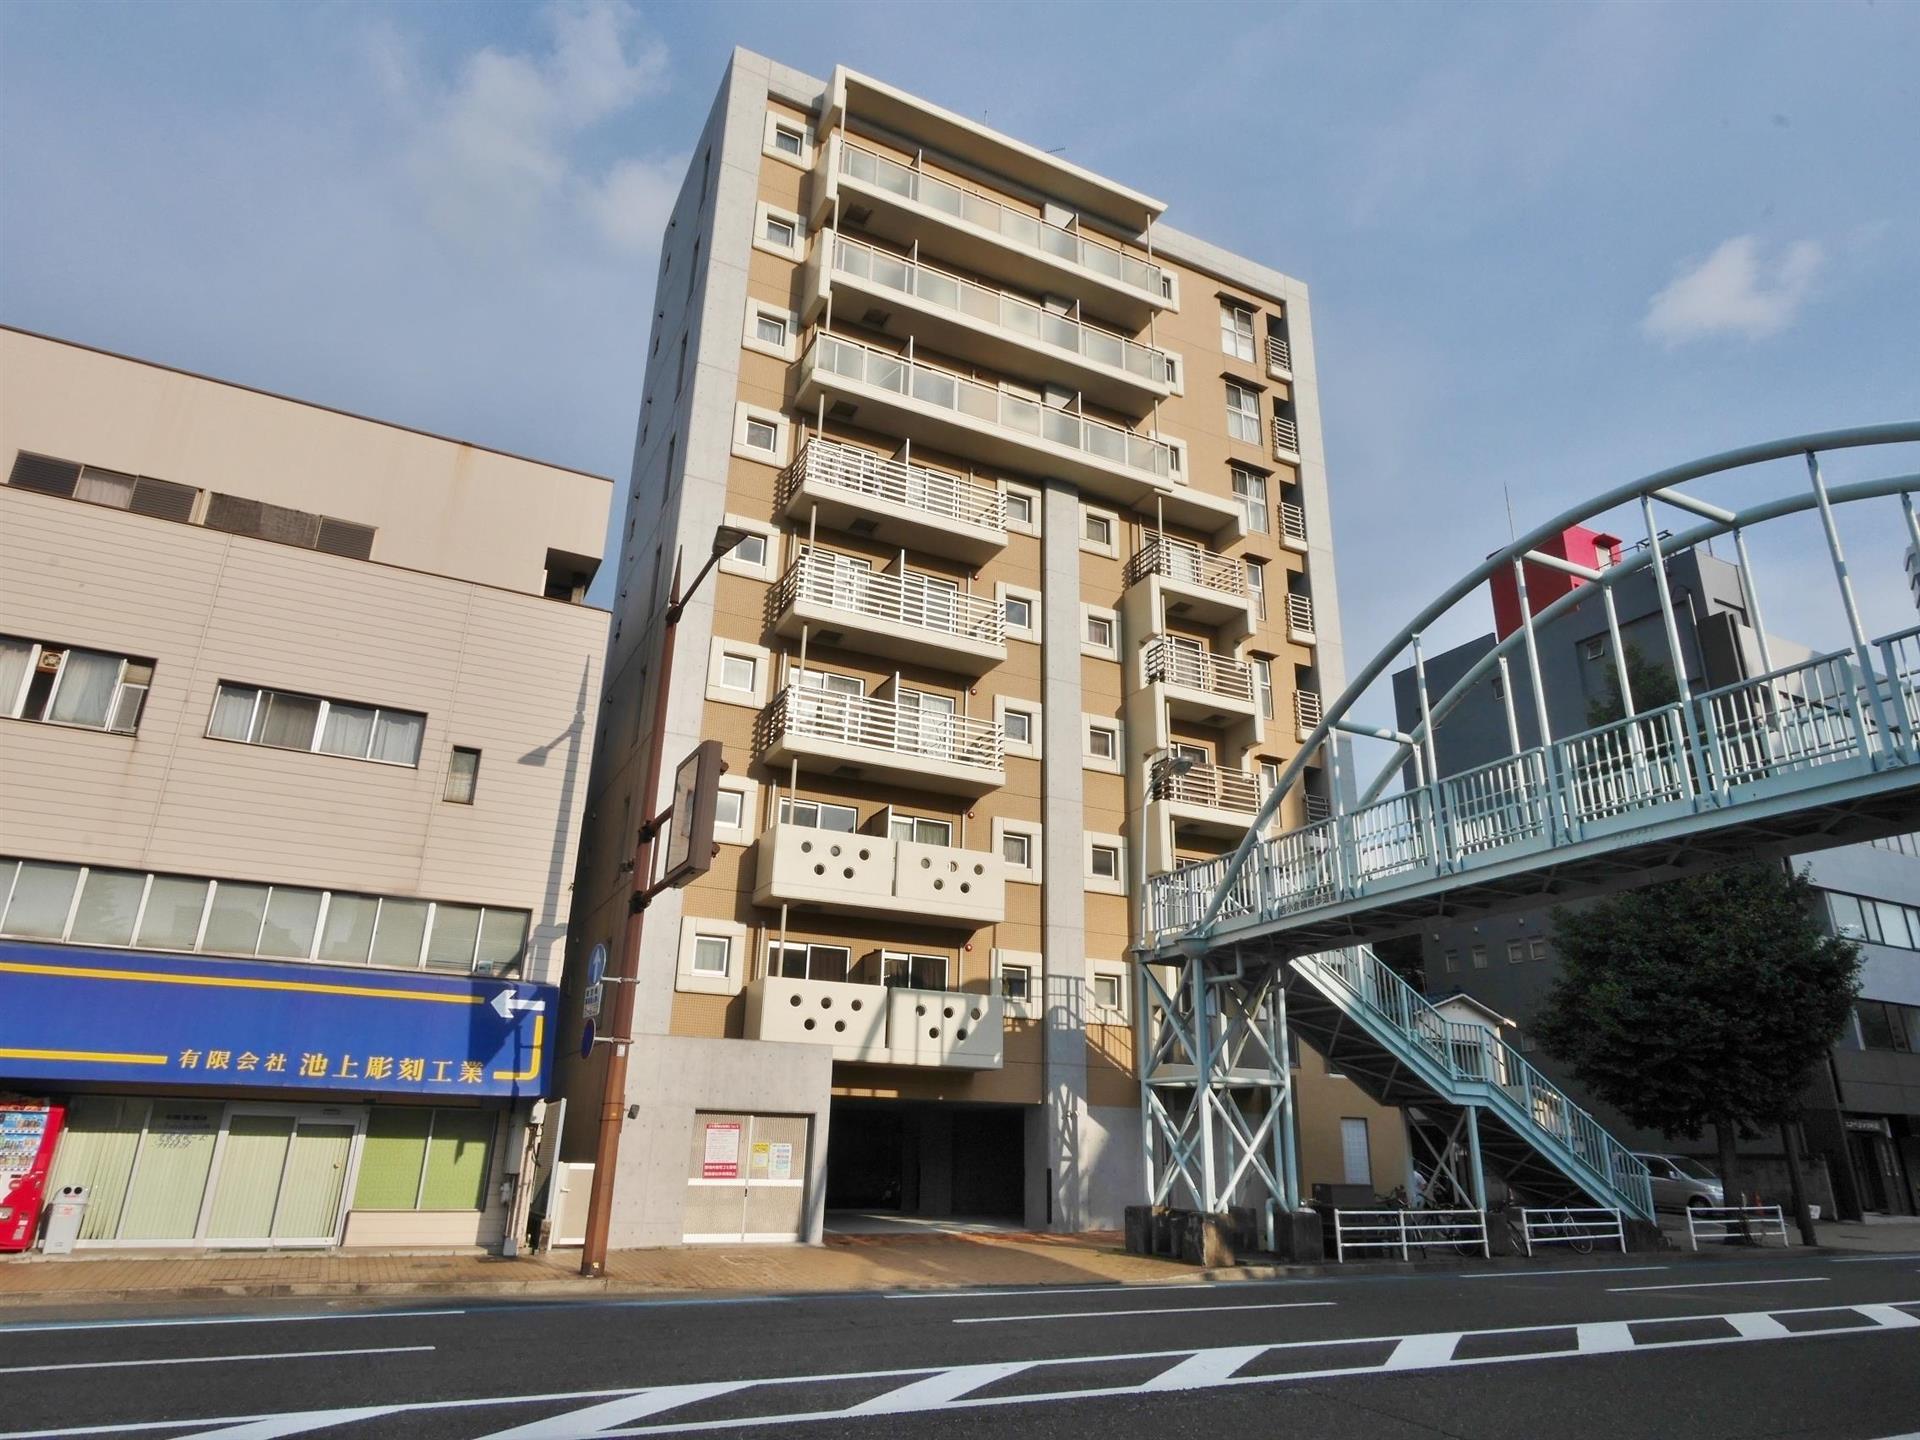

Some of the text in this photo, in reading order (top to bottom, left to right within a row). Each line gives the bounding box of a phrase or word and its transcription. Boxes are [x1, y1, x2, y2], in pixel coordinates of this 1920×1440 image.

[178, 1049, 484, 1083] 有限会社 池上彫刻工業
